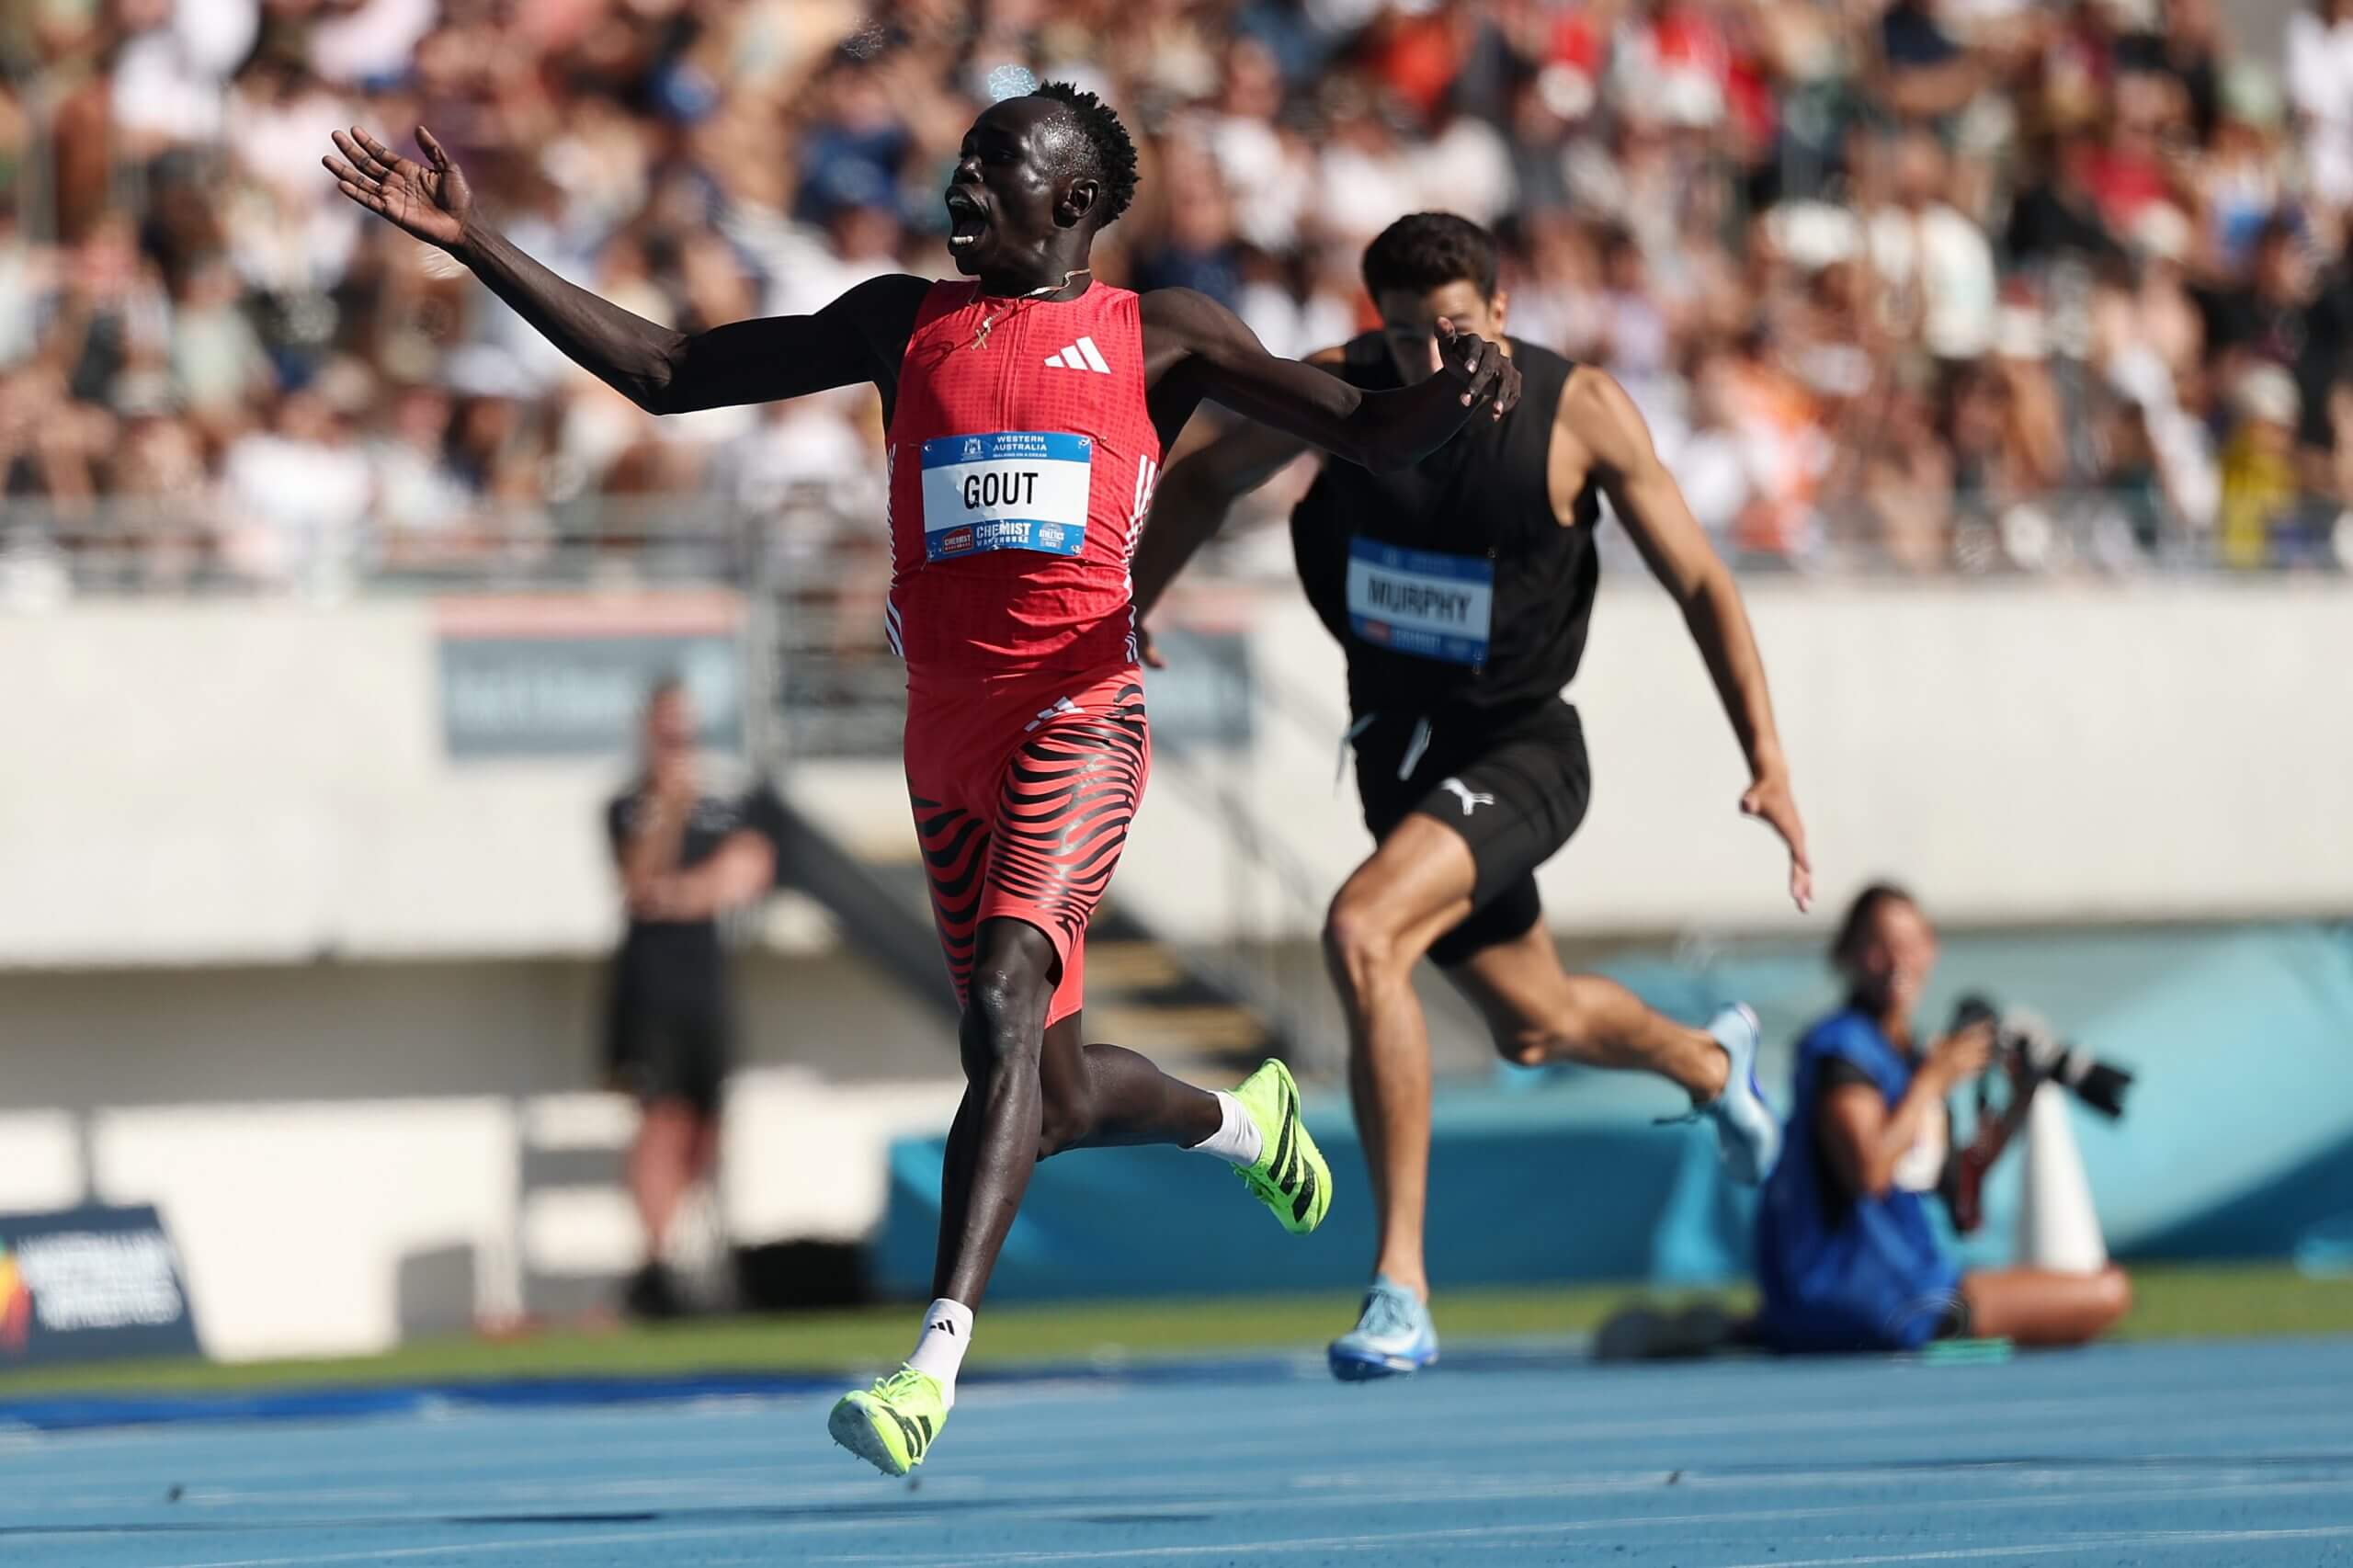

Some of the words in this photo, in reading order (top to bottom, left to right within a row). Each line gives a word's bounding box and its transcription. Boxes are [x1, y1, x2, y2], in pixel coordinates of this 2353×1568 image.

[963, 472, 1039, 509] GOUT
[976, 522, 1031, 540] CHEMIST
[1369, 577, 1472, 623] MURPHY
